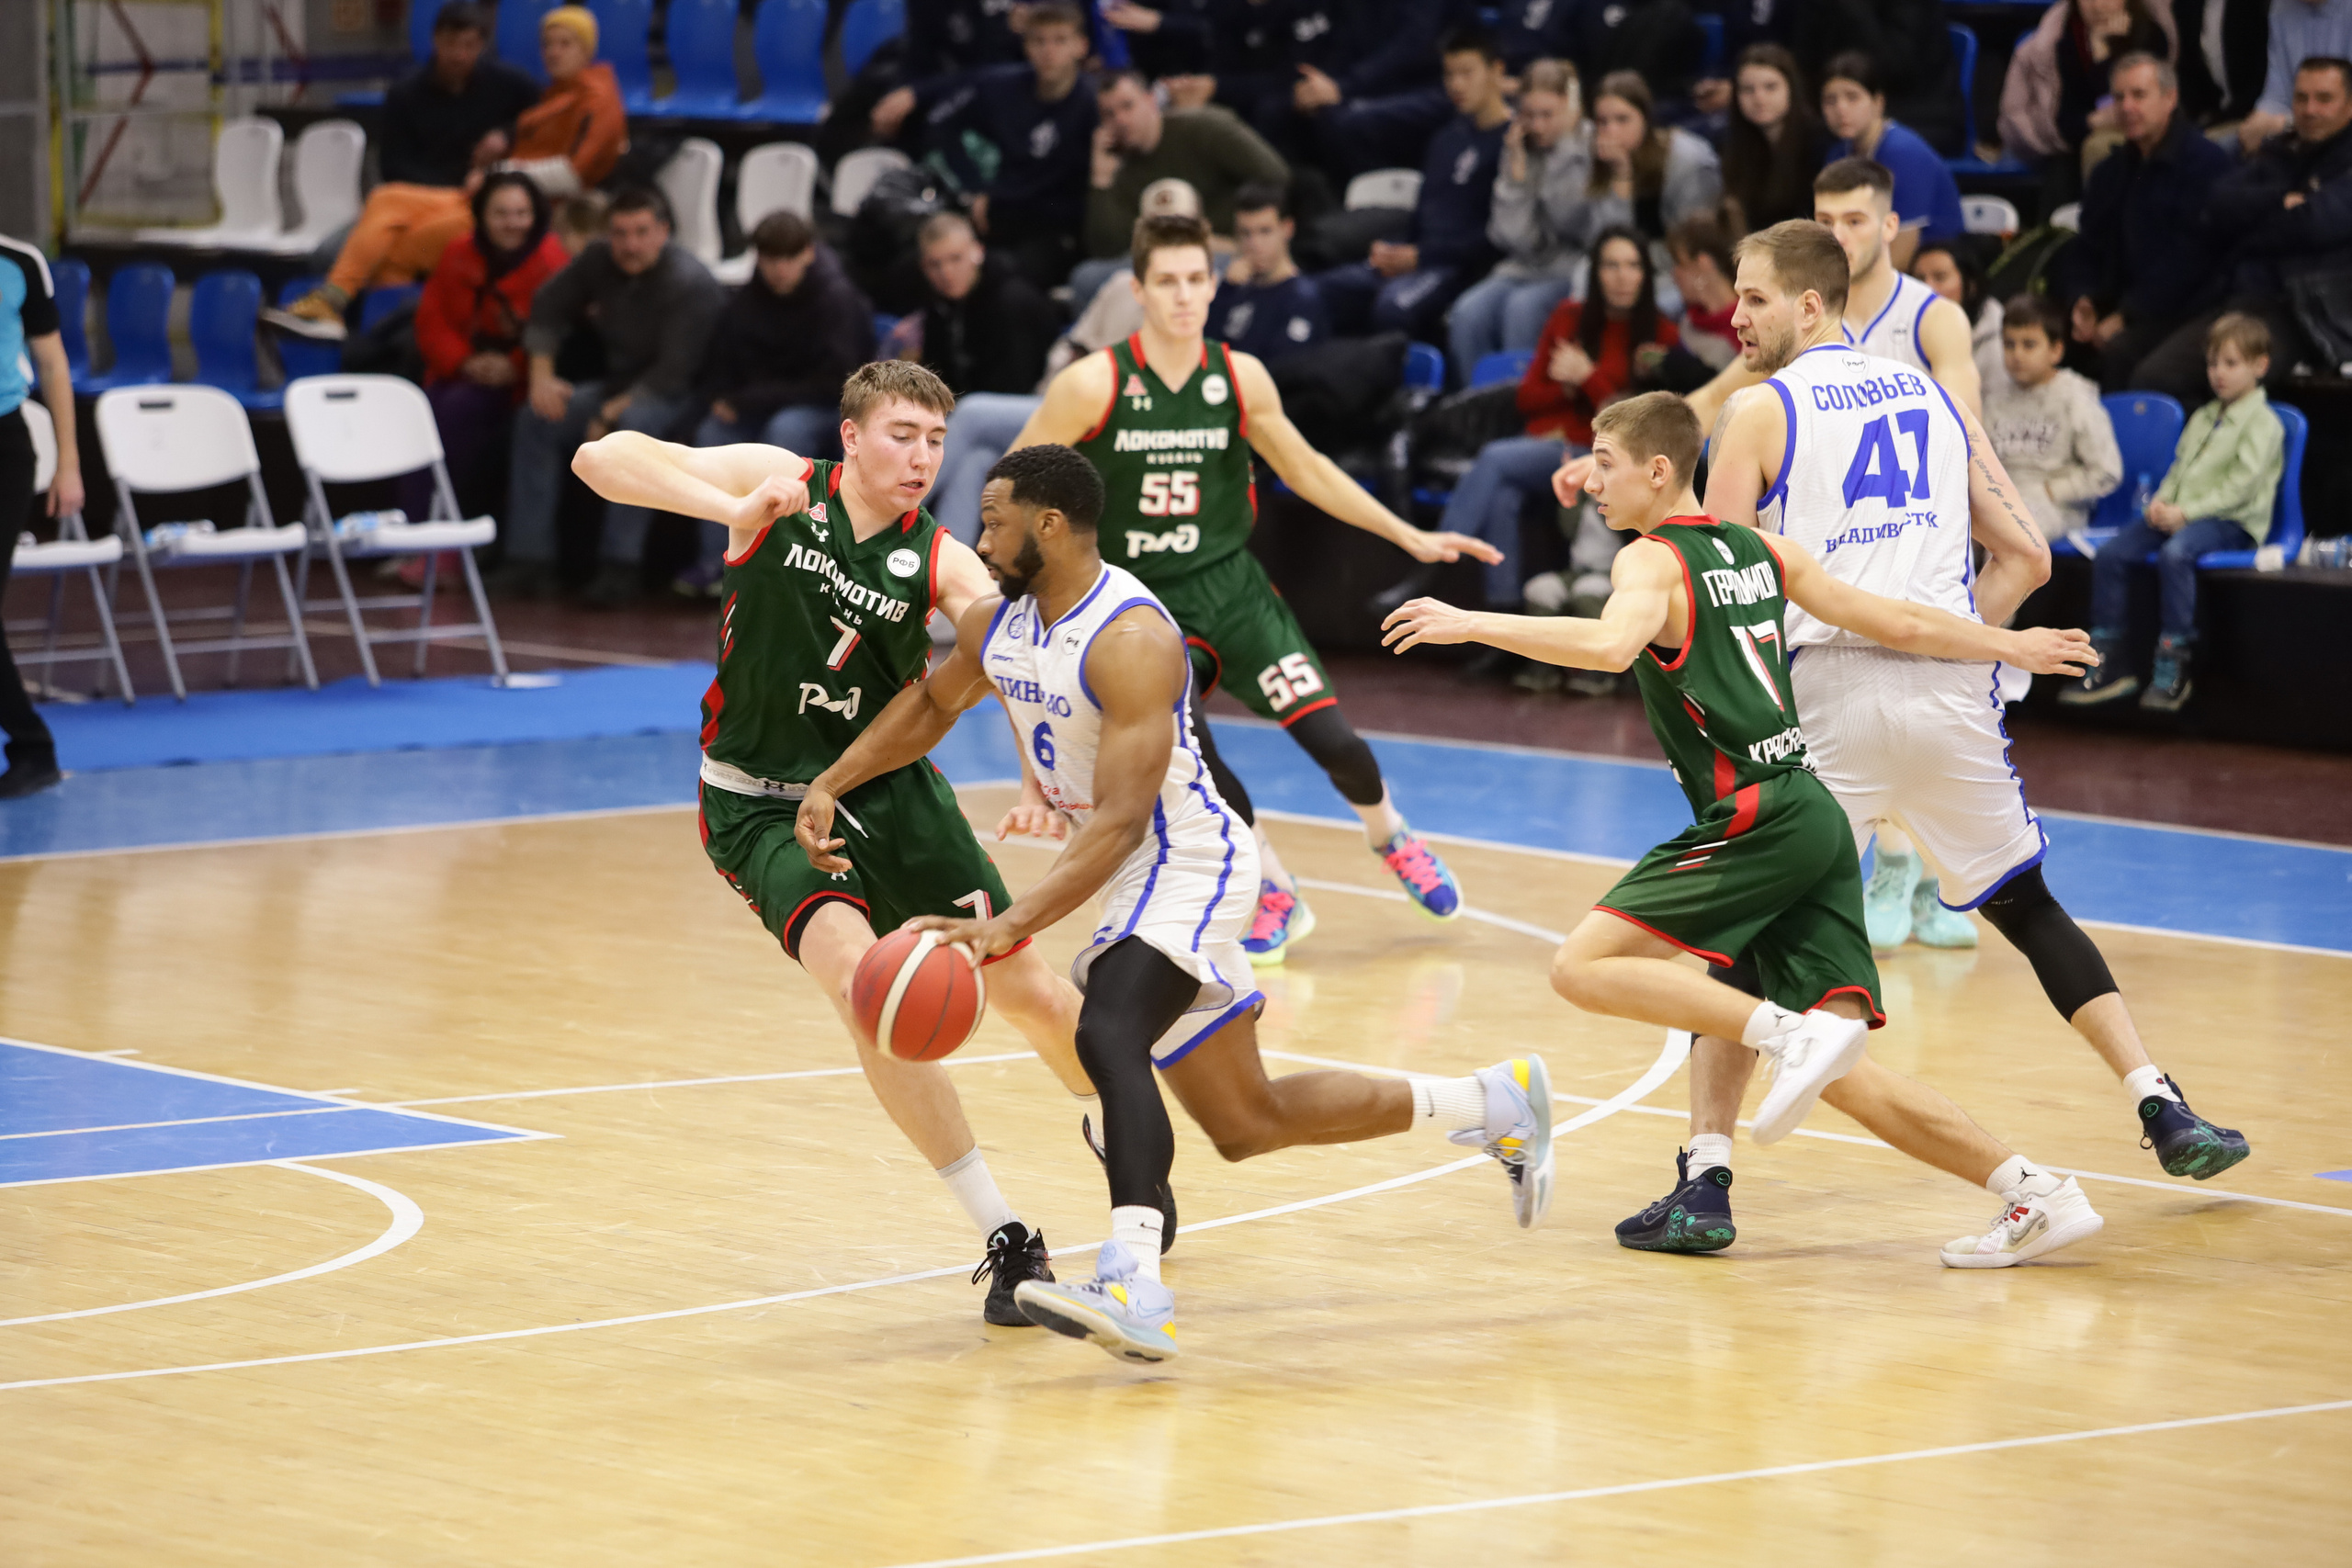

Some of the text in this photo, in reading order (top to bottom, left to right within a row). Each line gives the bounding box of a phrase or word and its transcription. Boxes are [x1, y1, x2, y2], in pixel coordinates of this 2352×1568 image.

[1842, 409, 1930, 509] 47
[1138, 470, 1200, 516] 55
[1987, 487, 2005, 499] go
[892, 557, 915, 569] РФБ
[826, 615, 861, 671] 7
[1729, 620, 1784, 712] 17
[1257, 651, 1325, 713] 55
[1033, 721, 1056, 771] 6
